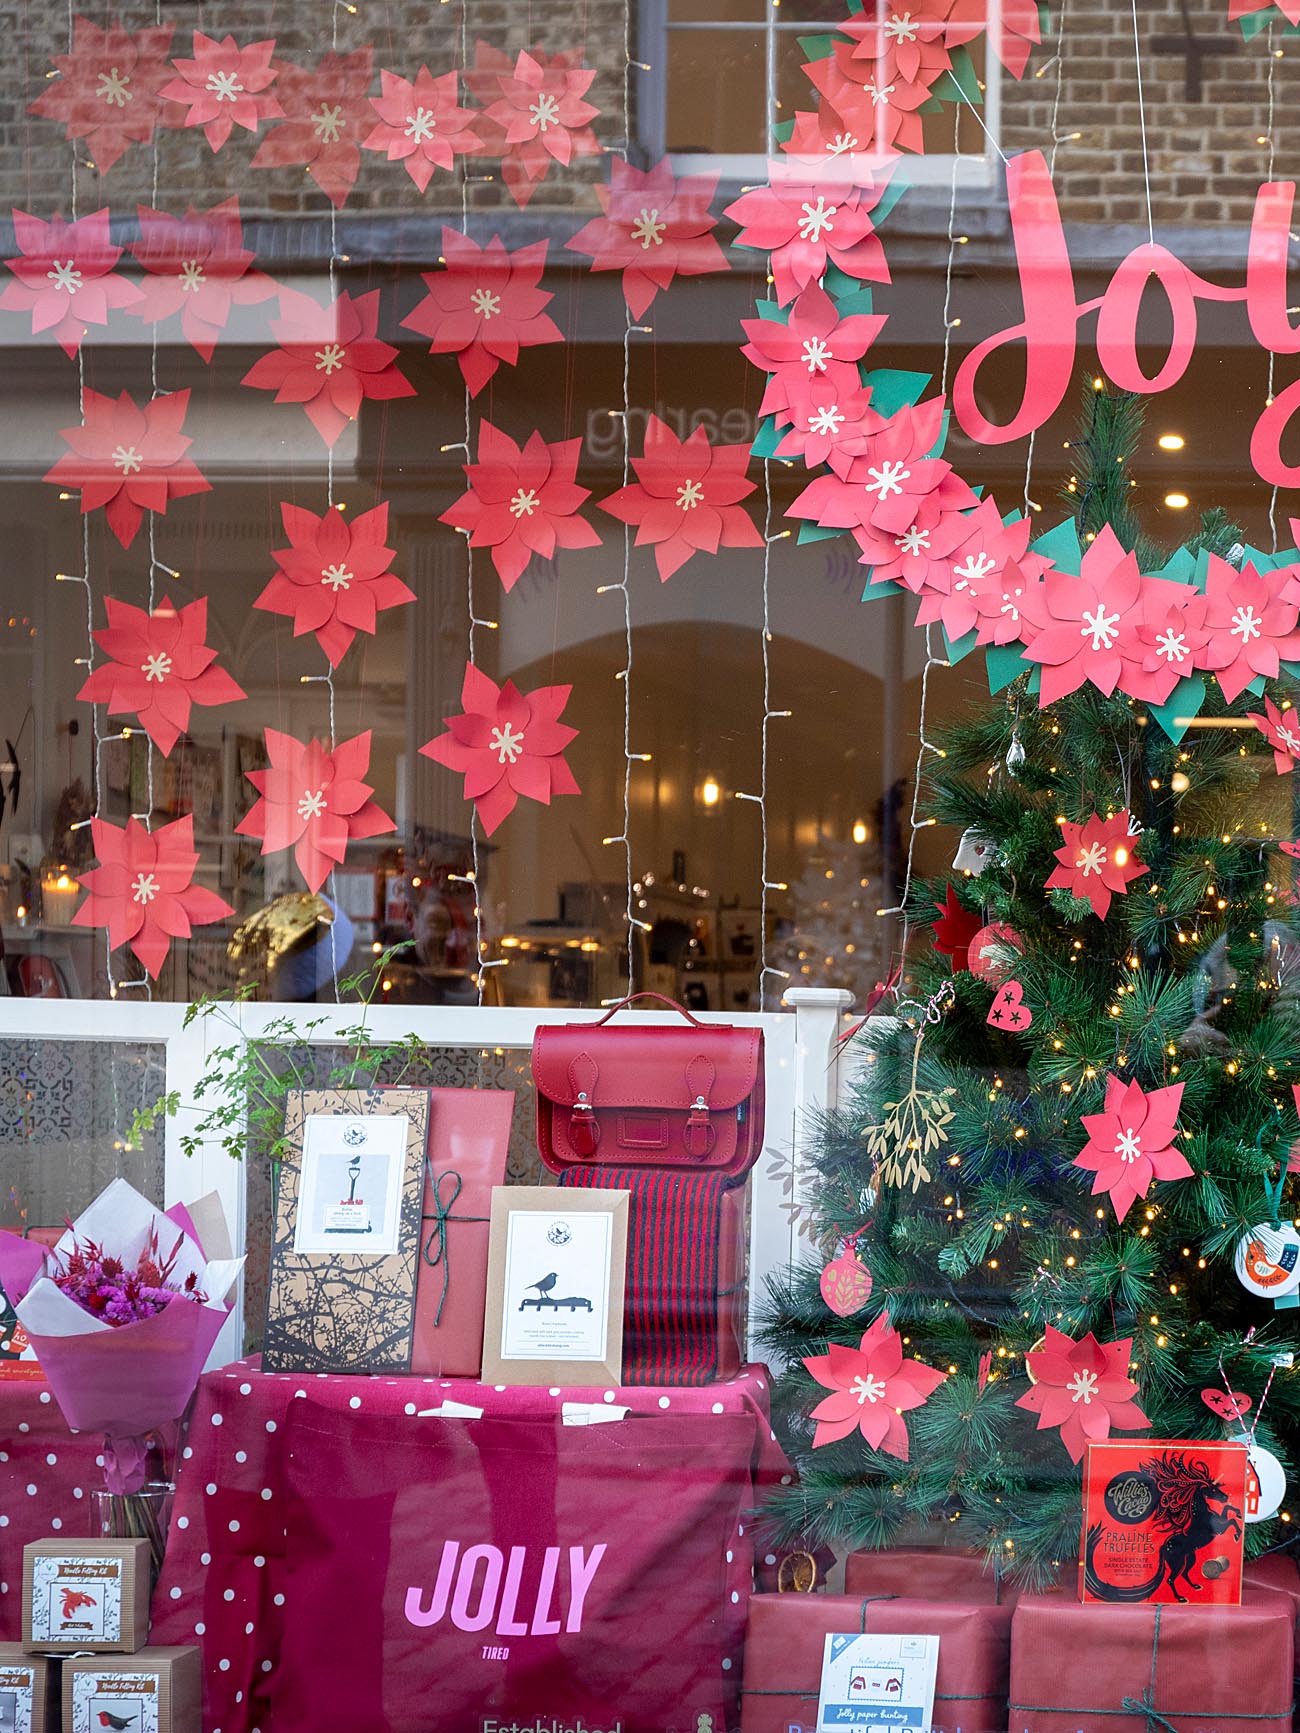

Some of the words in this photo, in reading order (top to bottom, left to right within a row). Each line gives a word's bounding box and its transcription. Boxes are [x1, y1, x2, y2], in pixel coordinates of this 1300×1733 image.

[1103, 1543, 1155, 1554] TRUFFLES
[404, 1540, 608, 1636] JOLLY
[482, 1646, 510, 1660] TIRED
[836, 1708, 856, 1722] Jolly
[856, 1711, 878, 1721] paper
[879, 1709, 908, 1723] bunting
